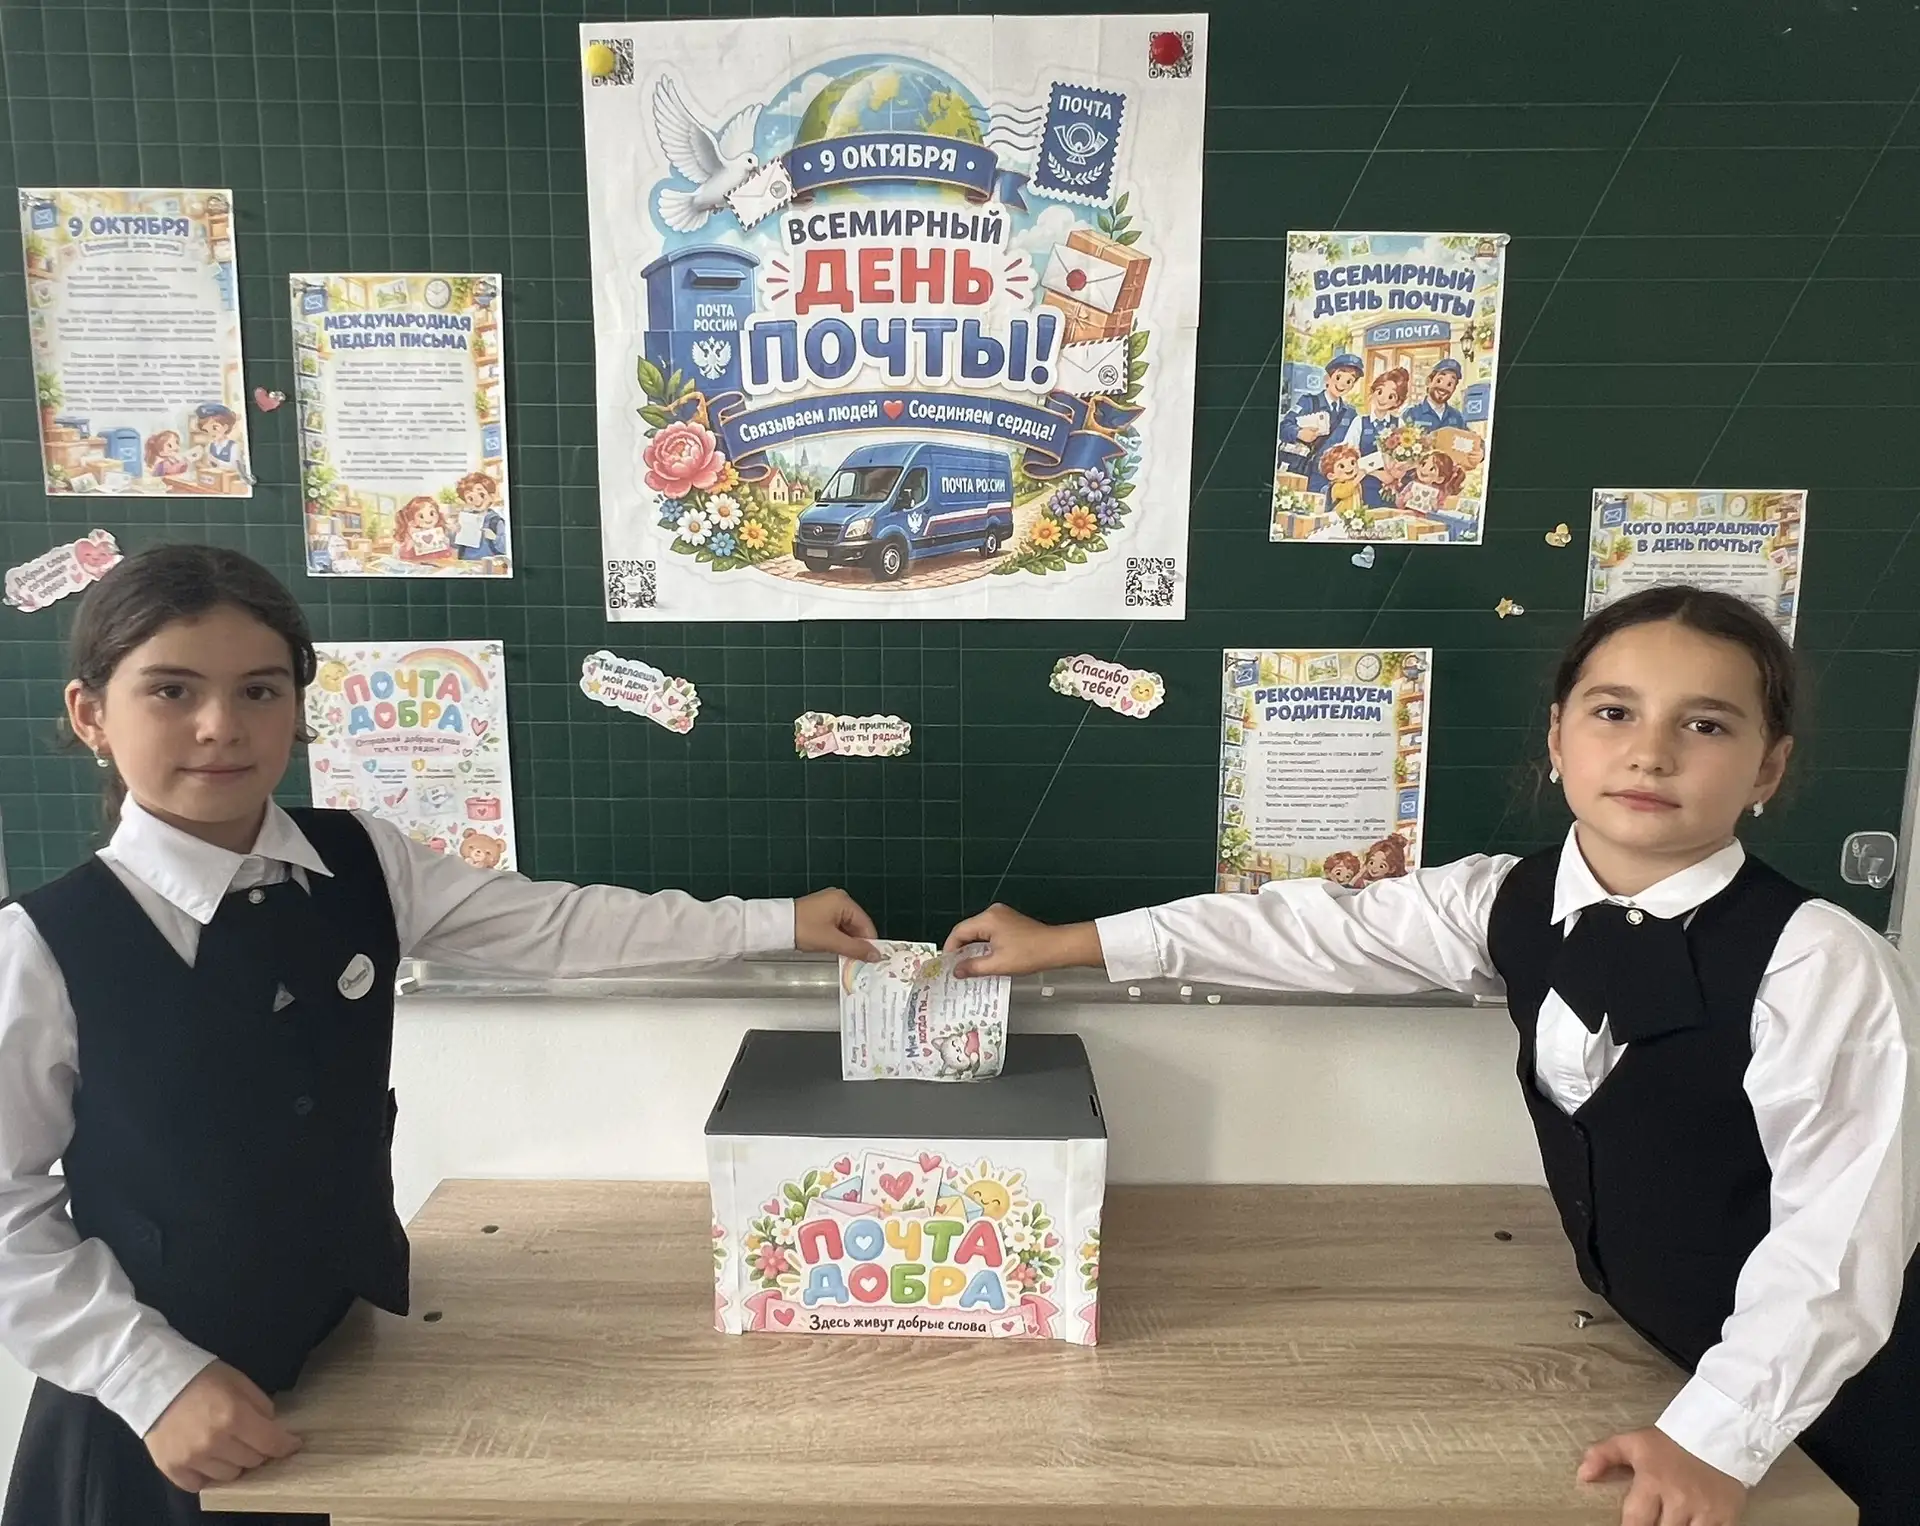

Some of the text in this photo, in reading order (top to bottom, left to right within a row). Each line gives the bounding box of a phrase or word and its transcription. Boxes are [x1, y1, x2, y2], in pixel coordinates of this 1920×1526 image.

[1059, 94, 1112, 120] ПОЧТА
[820, 143, 958, 173] 9 ОКТЯБРЯ
[68, 216, 189, 237] 9 ОКТЯБРЯ
[788, 209, 1003, 245] ВСЕМИРНЫЙ
[795, 248, 994, 315] ДЕНЬ
[1313, 263, 1475, 293] ВСЕМИРНЫЙ
[696, 304, 735, 317] ПОЧТА
[1313, 289, 1475, 318] ДЕНЬ ПОЧТЫ
[324, 313, 472, 332] МЕЖДУНАРОДНАЯ
[693, 319, 738, 332] РОССИИ
[1395, 323, 1441, 339] ПОЧТА
[330, 333, 468, 350] НЕДЕЛЯ ПИСЬМА
[751, 315, 1056, 386] ПОЧТЫ!
[739, 400, 1057, 442] Связываем людей Соединяем сердца!
[942, 477, 974, 493] ПОЧТА
[1623, 522, 1778, 537] КОГО ПОЗДРАВЛЯЮТ
[1637, 538, 1763, 553] В ДЕНЬ ПОЧТЫ?
[600, 659, 657, 683] Ты делаешь
[1072, 660, 1129, 685] Спасибо
[344, 669, 462, 705] ПОЧТА
[602, 674, 649, 691] мой день
[1082, 680, 1121, 699] тебе!
[603, 687, 649, 704] лучше!
[1254, 687, 1392, 704] РЕКОМЕНДУЕМ
[348, 700, 463, 735] ДОБРА
[1265, 704, 1382, 721] РОДИТЕЛЯМ
[837, 722, 856, 732] Мне
[917, 1015, 928, 1044] когда
[905, 1034, 920, 1058] Мне
[800, 1218, 1003, 1267] ПОЧТА
[803, 1263, 1006, 1310] ДОБРА
[809, 1314, 986, 1332] Здесь живут добрые слова
